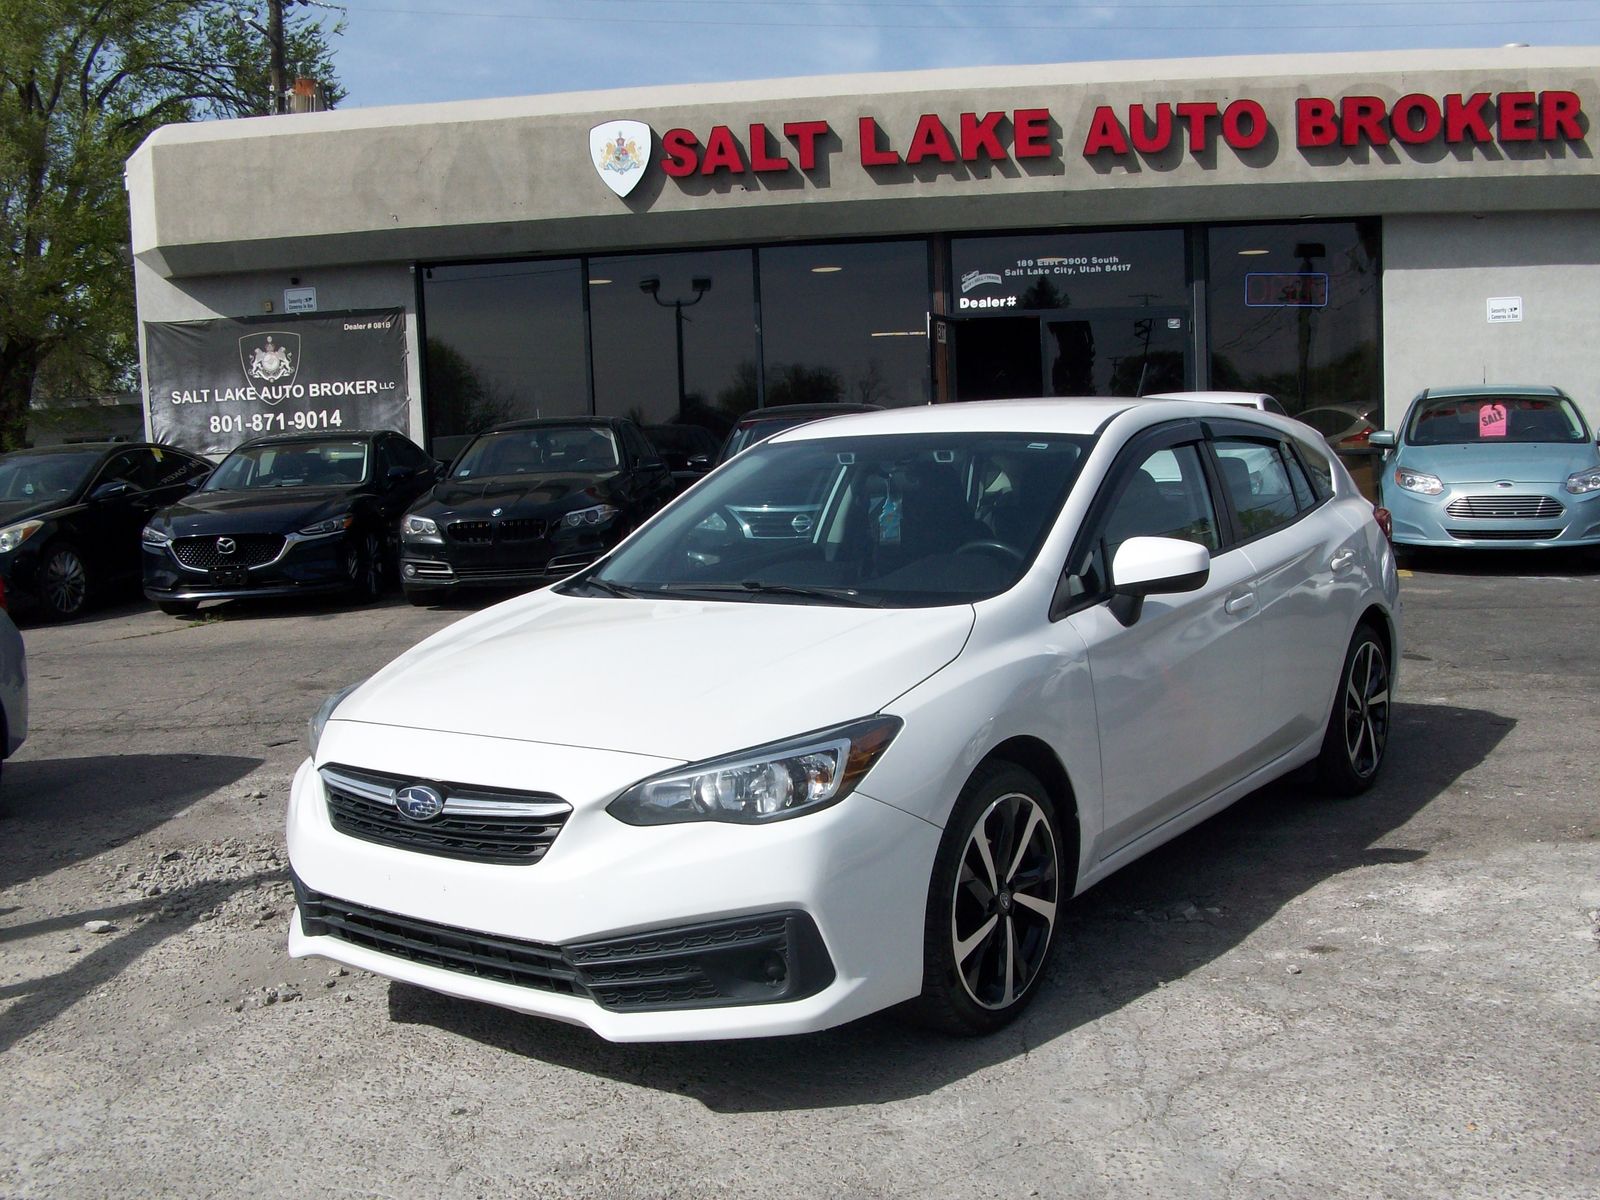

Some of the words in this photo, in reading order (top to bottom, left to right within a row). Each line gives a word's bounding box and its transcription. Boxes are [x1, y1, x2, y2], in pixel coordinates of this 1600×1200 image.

[660, 120, 828, 177] SALT
[860, 108, 1053, 167] LAKE
[1083, 99, 1269, 157] AUTO
[1296, 90, 1586, 148] BROKER
[1017, 259, 1034, 267] 189
[1037, 258, 1058, 266] East
[1062, 257, 1088, 265] 3900
[1091, 256, 1119, 264] South
[1004, 268, 1024, 276] Salt
[1054, 266, 1076, 275] City,
[1079, 265, 1101, 273] Utah
[1105, 264, 1131, 272] 84117
[959, 296, 1017, 308] Dealer#
[343, 322, 367, 331] Dealer
[171, 389, 210, 404] SALT
[214, 387, 257, 402] LAKE
[261, 384, 304, 400] AUTO
[309, 380, 378, 397] BROKER
[379, 381, 395, 390] LLC
[209, 409, 342, 433] 801-871-9014
[1481, 410, 1504, 427] SALE
